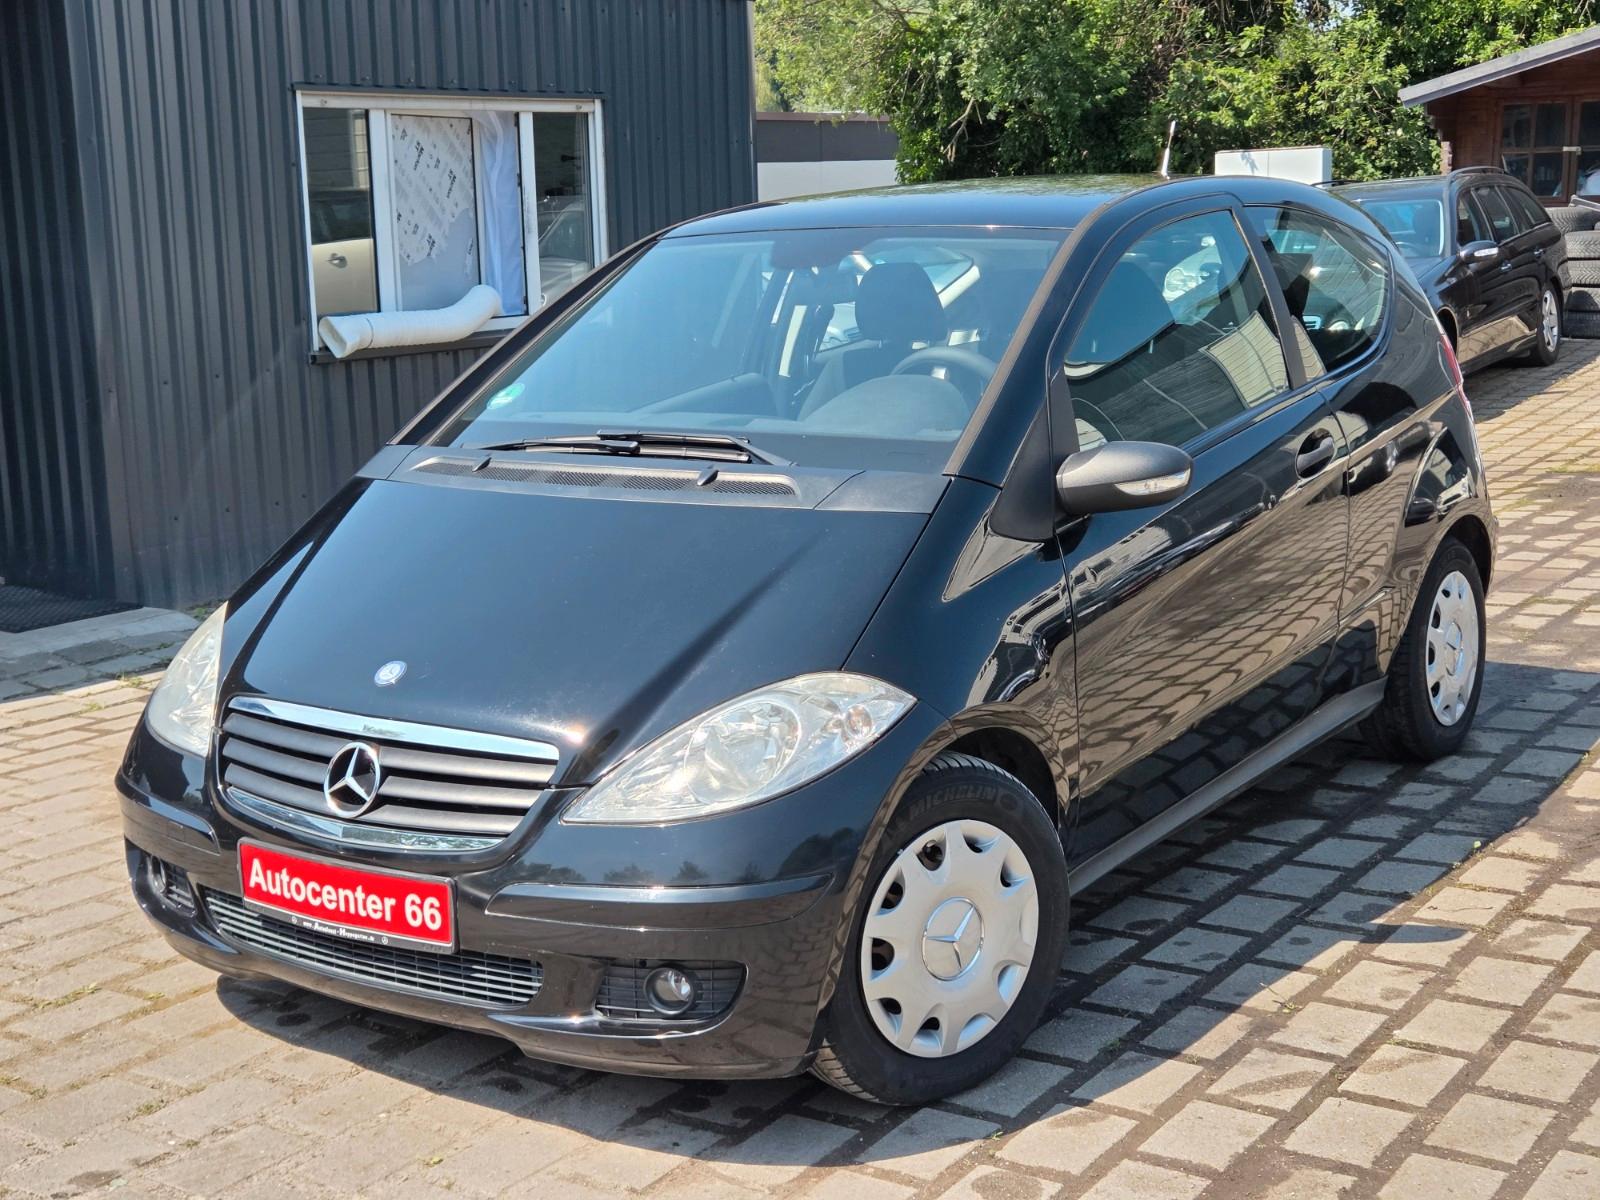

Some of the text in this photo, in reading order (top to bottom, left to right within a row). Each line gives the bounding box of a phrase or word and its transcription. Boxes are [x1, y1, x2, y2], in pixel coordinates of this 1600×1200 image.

[909, 784, 998, 820] MICHELIN
[249, 857, 396, 922] Autocenter
[404, 892, 442, 931] 66
